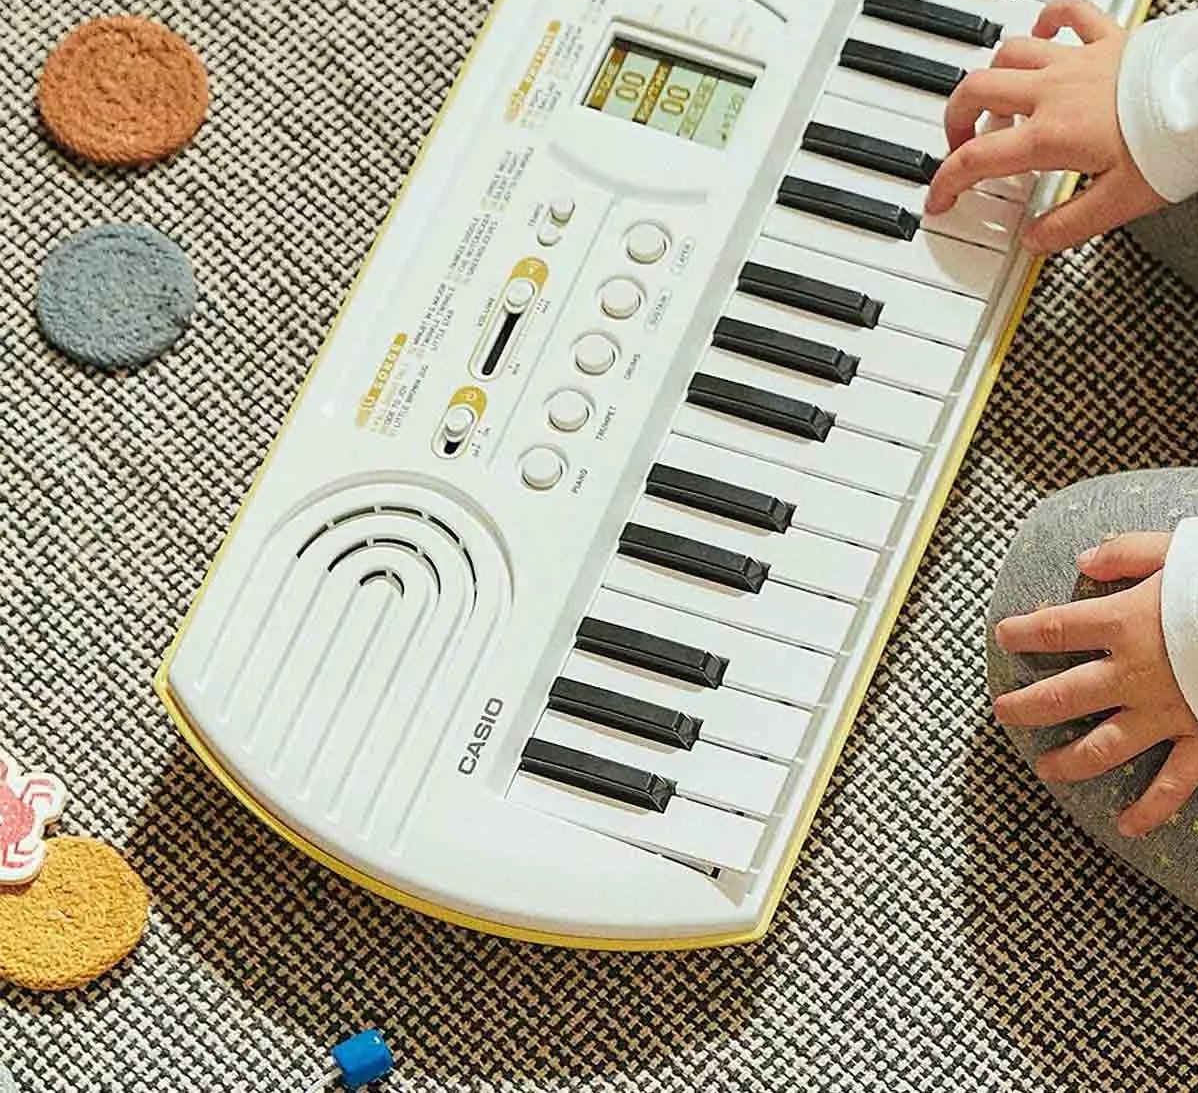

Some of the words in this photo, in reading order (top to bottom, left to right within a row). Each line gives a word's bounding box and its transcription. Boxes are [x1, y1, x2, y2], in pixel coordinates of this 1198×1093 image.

[624, 352, 642, 380] DRUMS
[596, 404, 619, 441] TRUMPET
[572, 467, 589, 494] PIANO
[458, 698, 503, 774] CASIO
